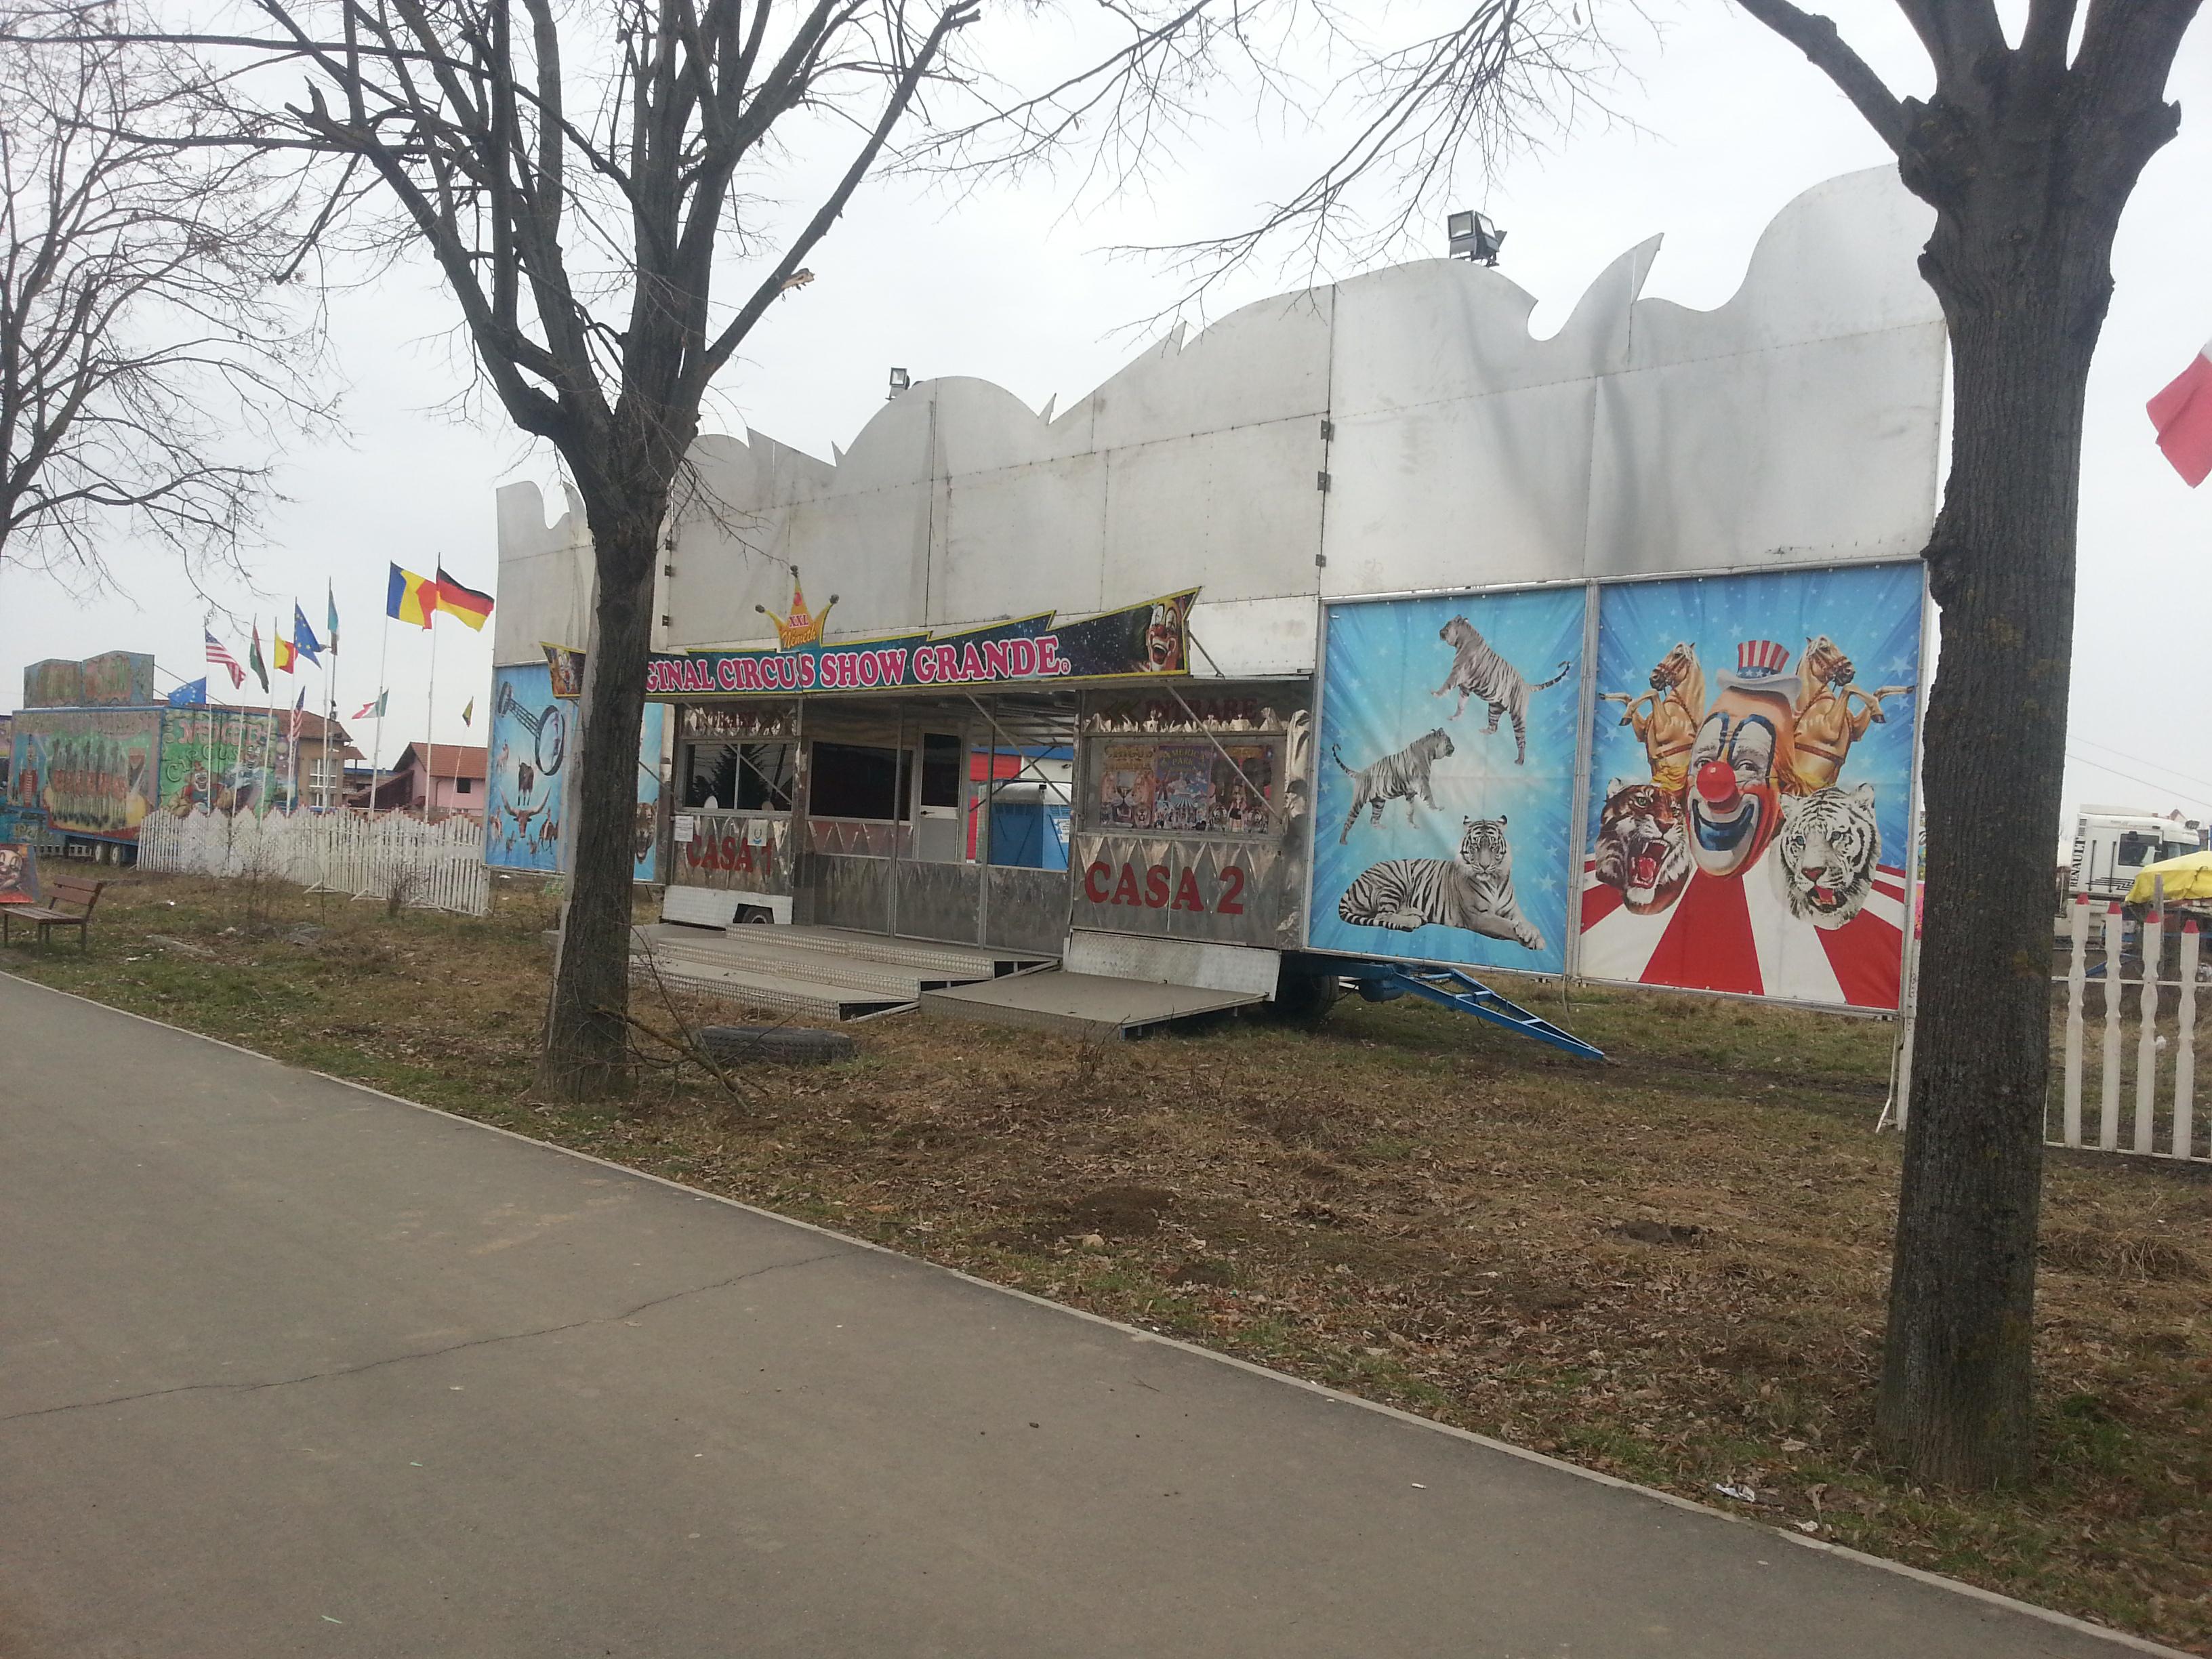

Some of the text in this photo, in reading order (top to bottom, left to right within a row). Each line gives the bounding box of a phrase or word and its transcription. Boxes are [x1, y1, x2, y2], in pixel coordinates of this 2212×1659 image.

[788, 613, 808, 628] XXL
[717, 652, 815, 690] CIRCUS
[819, 649, 907, 689] SHOW
[913, 635, 1061, 683] GRANDE
[687, 834, 753, 873] CASA
[2070, 837, 2087, 887] RENAULT
[1084, 861, 1244, 914] CASA 2
